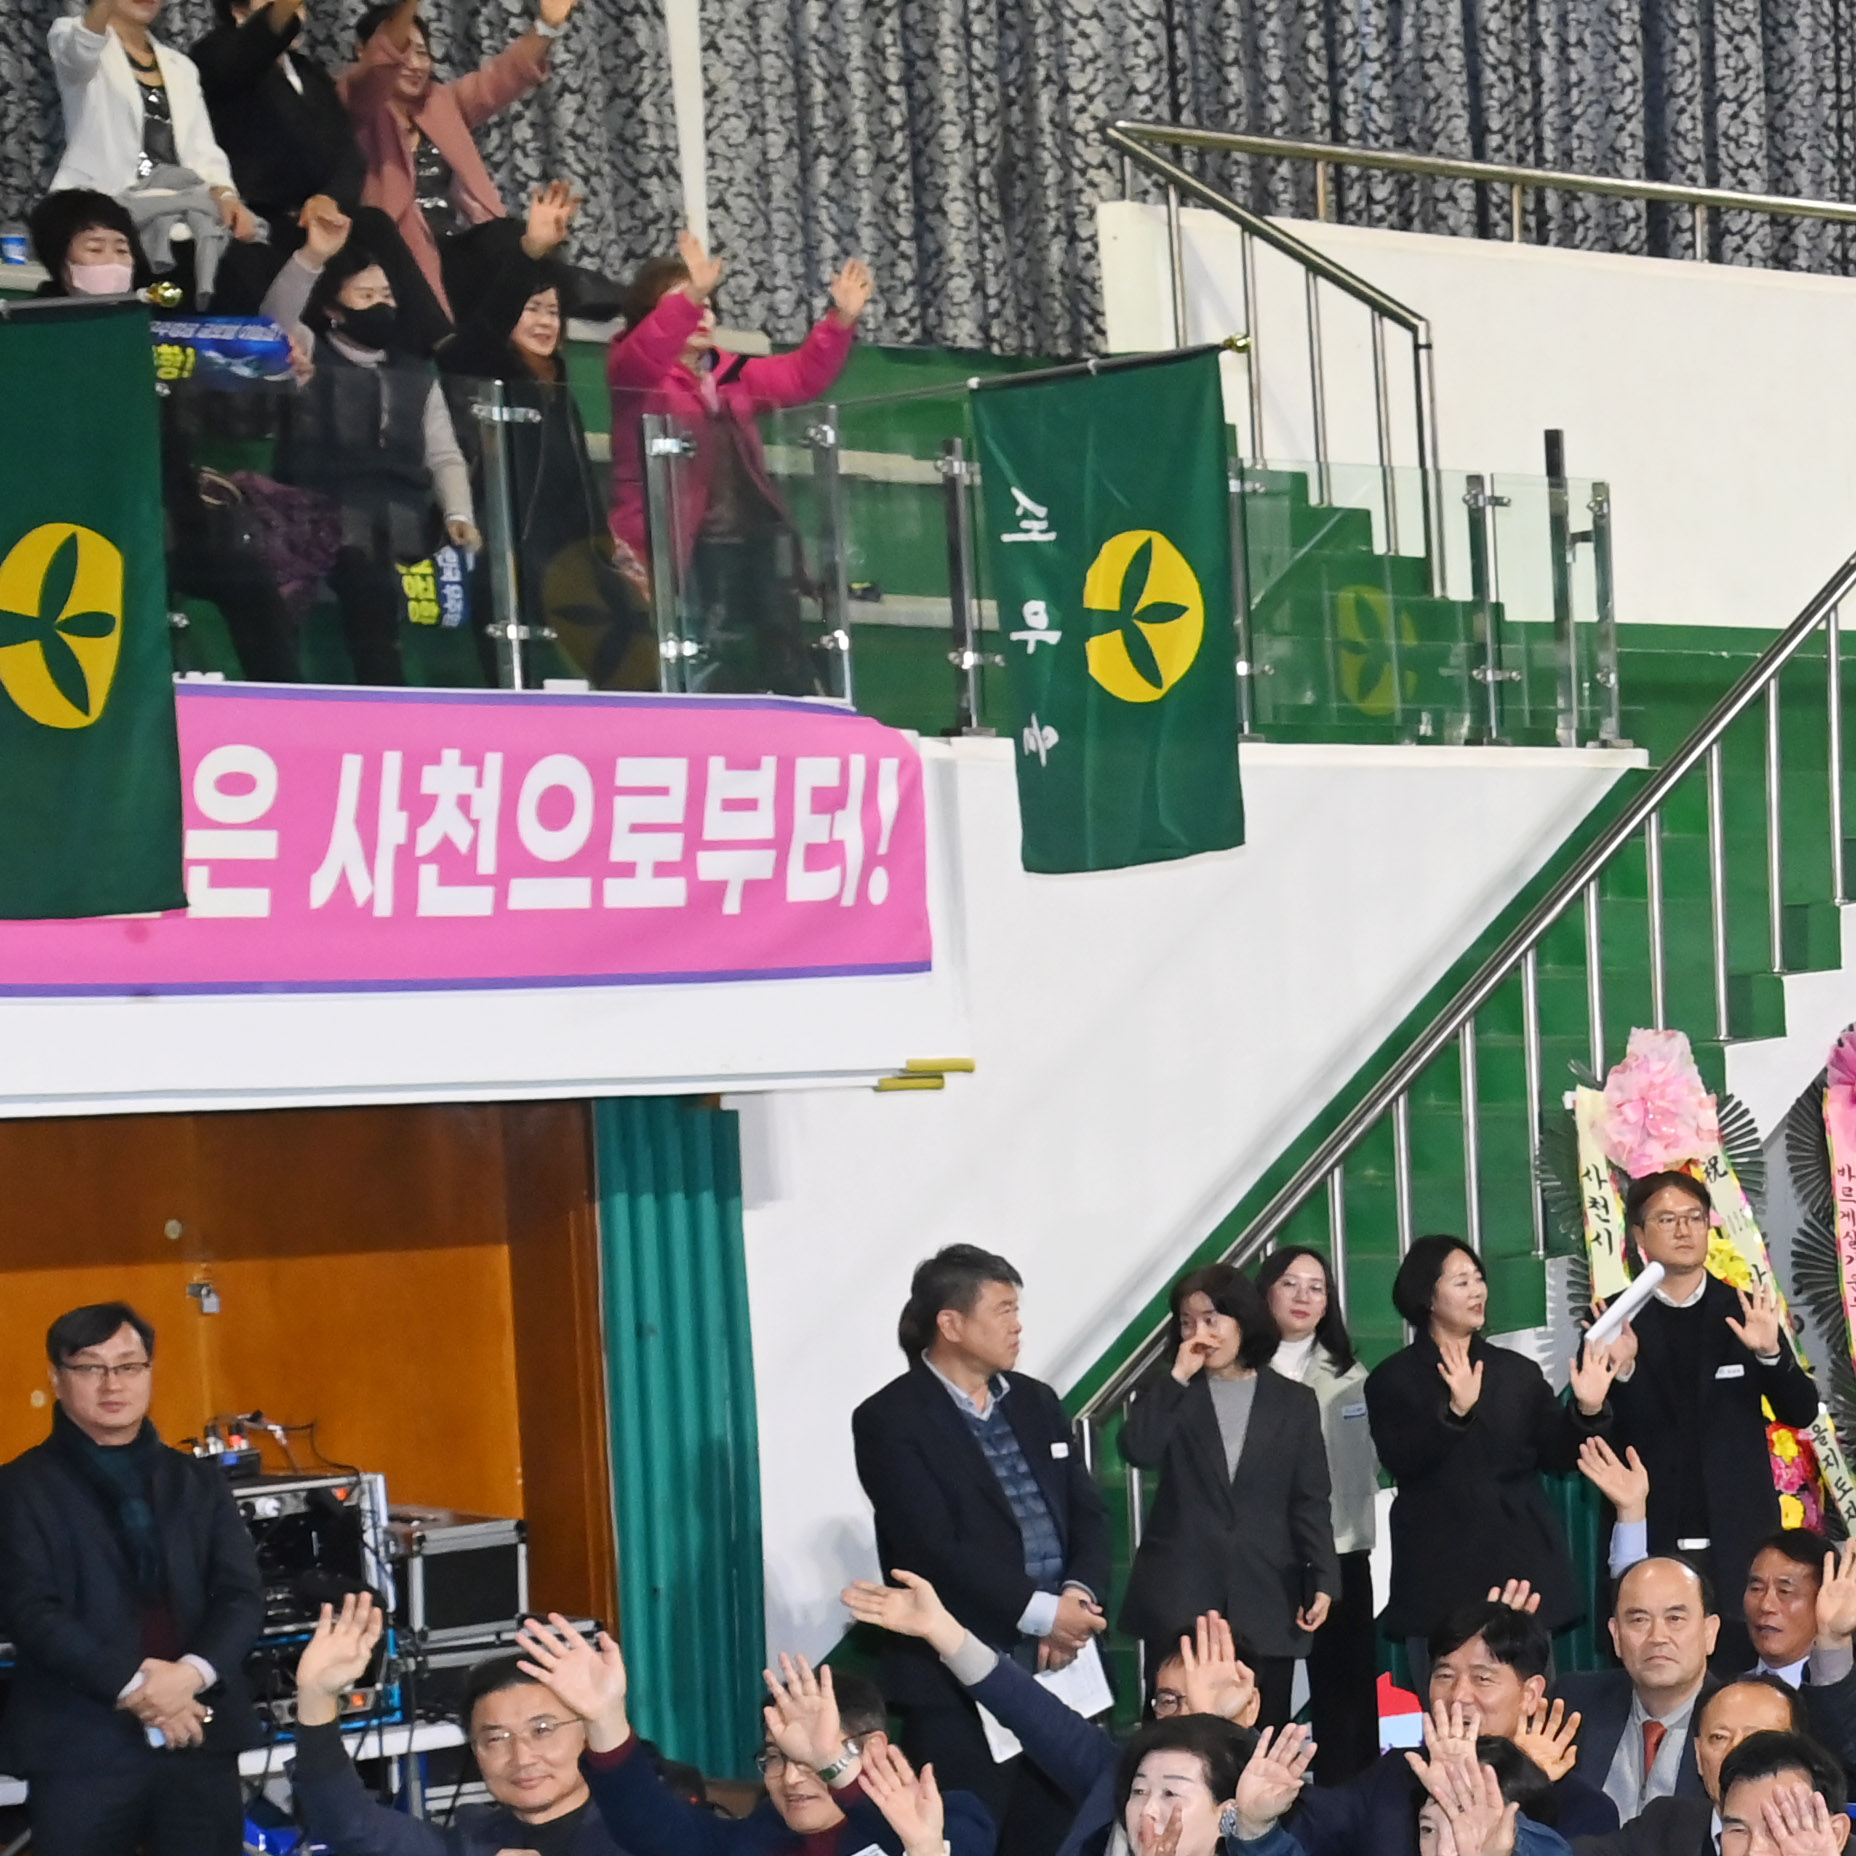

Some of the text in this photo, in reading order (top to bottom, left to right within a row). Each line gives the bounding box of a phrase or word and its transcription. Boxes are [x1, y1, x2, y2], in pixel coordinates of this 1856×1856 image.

[1000, 486, 1062, 767] 새마을
[309, 747, 900, 918] 사천으로부터!
[1580, 1164, 1616, 1257] 사천시
